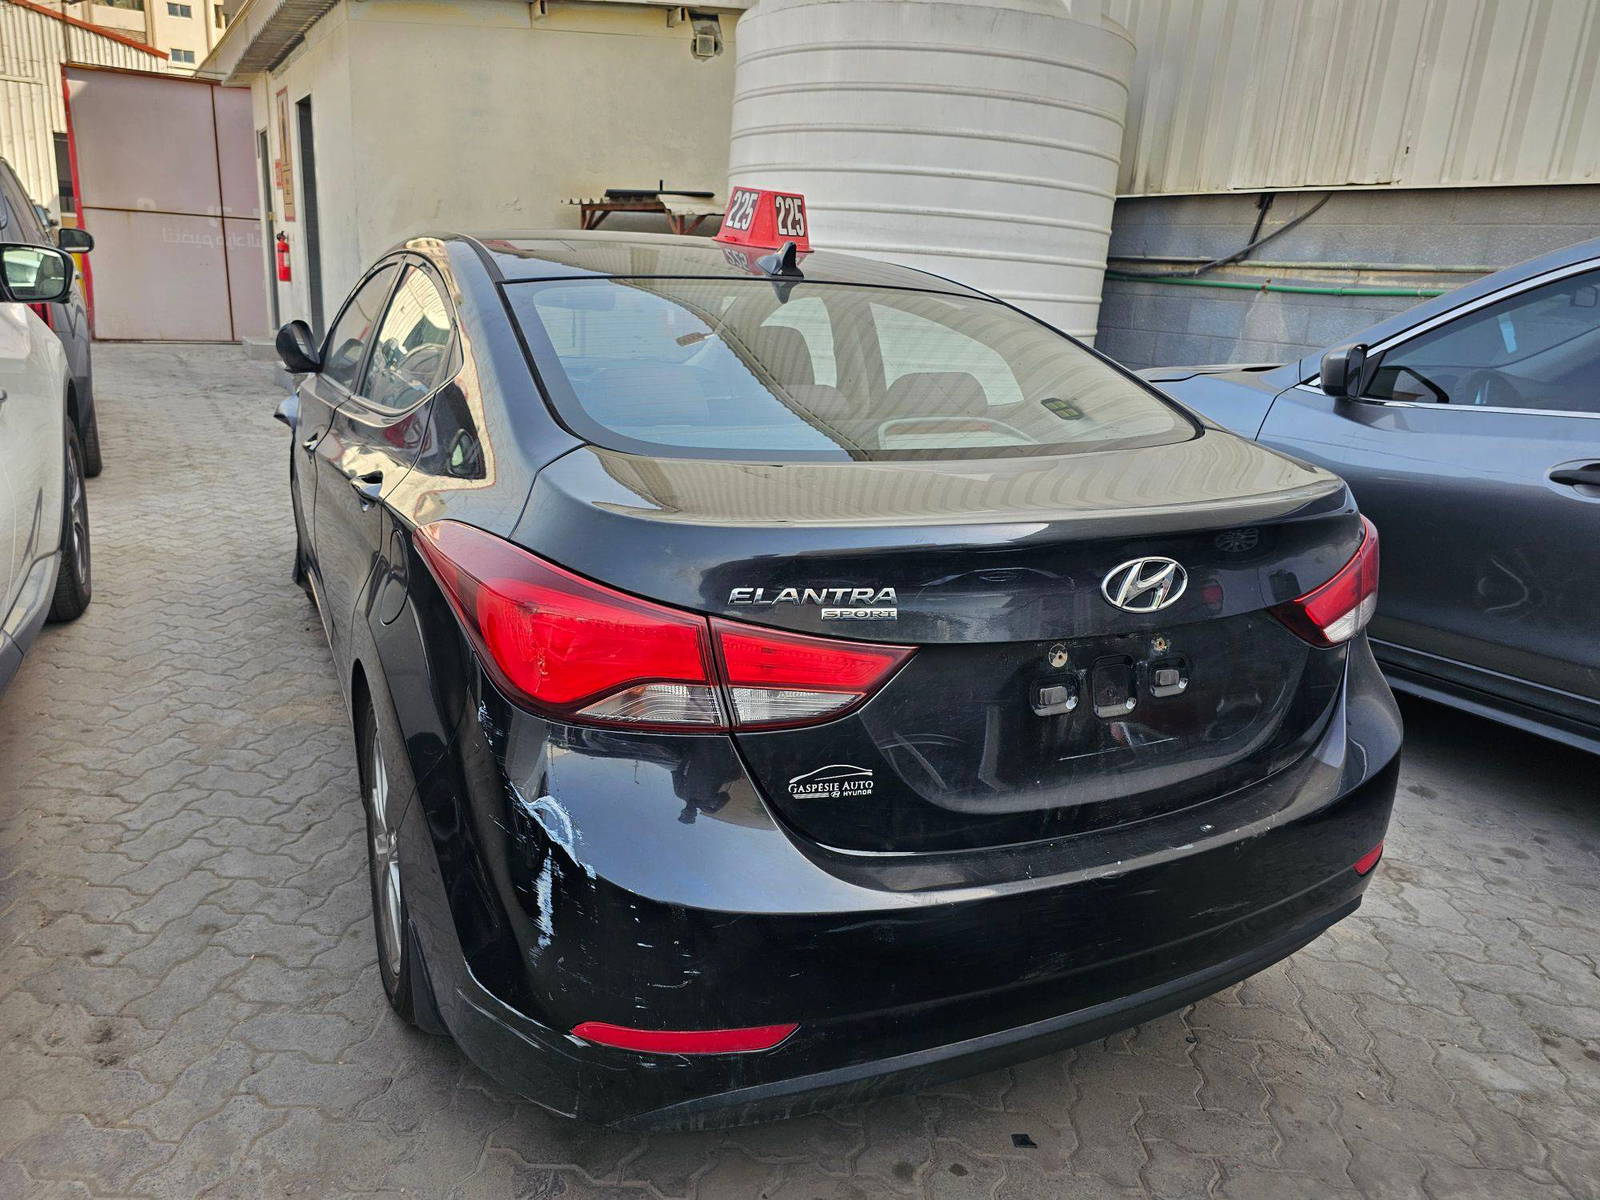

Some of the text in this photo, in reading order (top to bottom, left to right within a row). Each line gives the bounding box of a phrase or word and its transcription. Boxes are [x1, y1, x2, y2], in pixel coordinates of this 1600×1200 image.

[725, 190, 758, 230] 225
[775, 196, 805, 237] 225
[728, 587, 898, 606] ELANTRA
[822, 610, 896, 619] SPORT
[842, 780, 874, 790] AUTO
